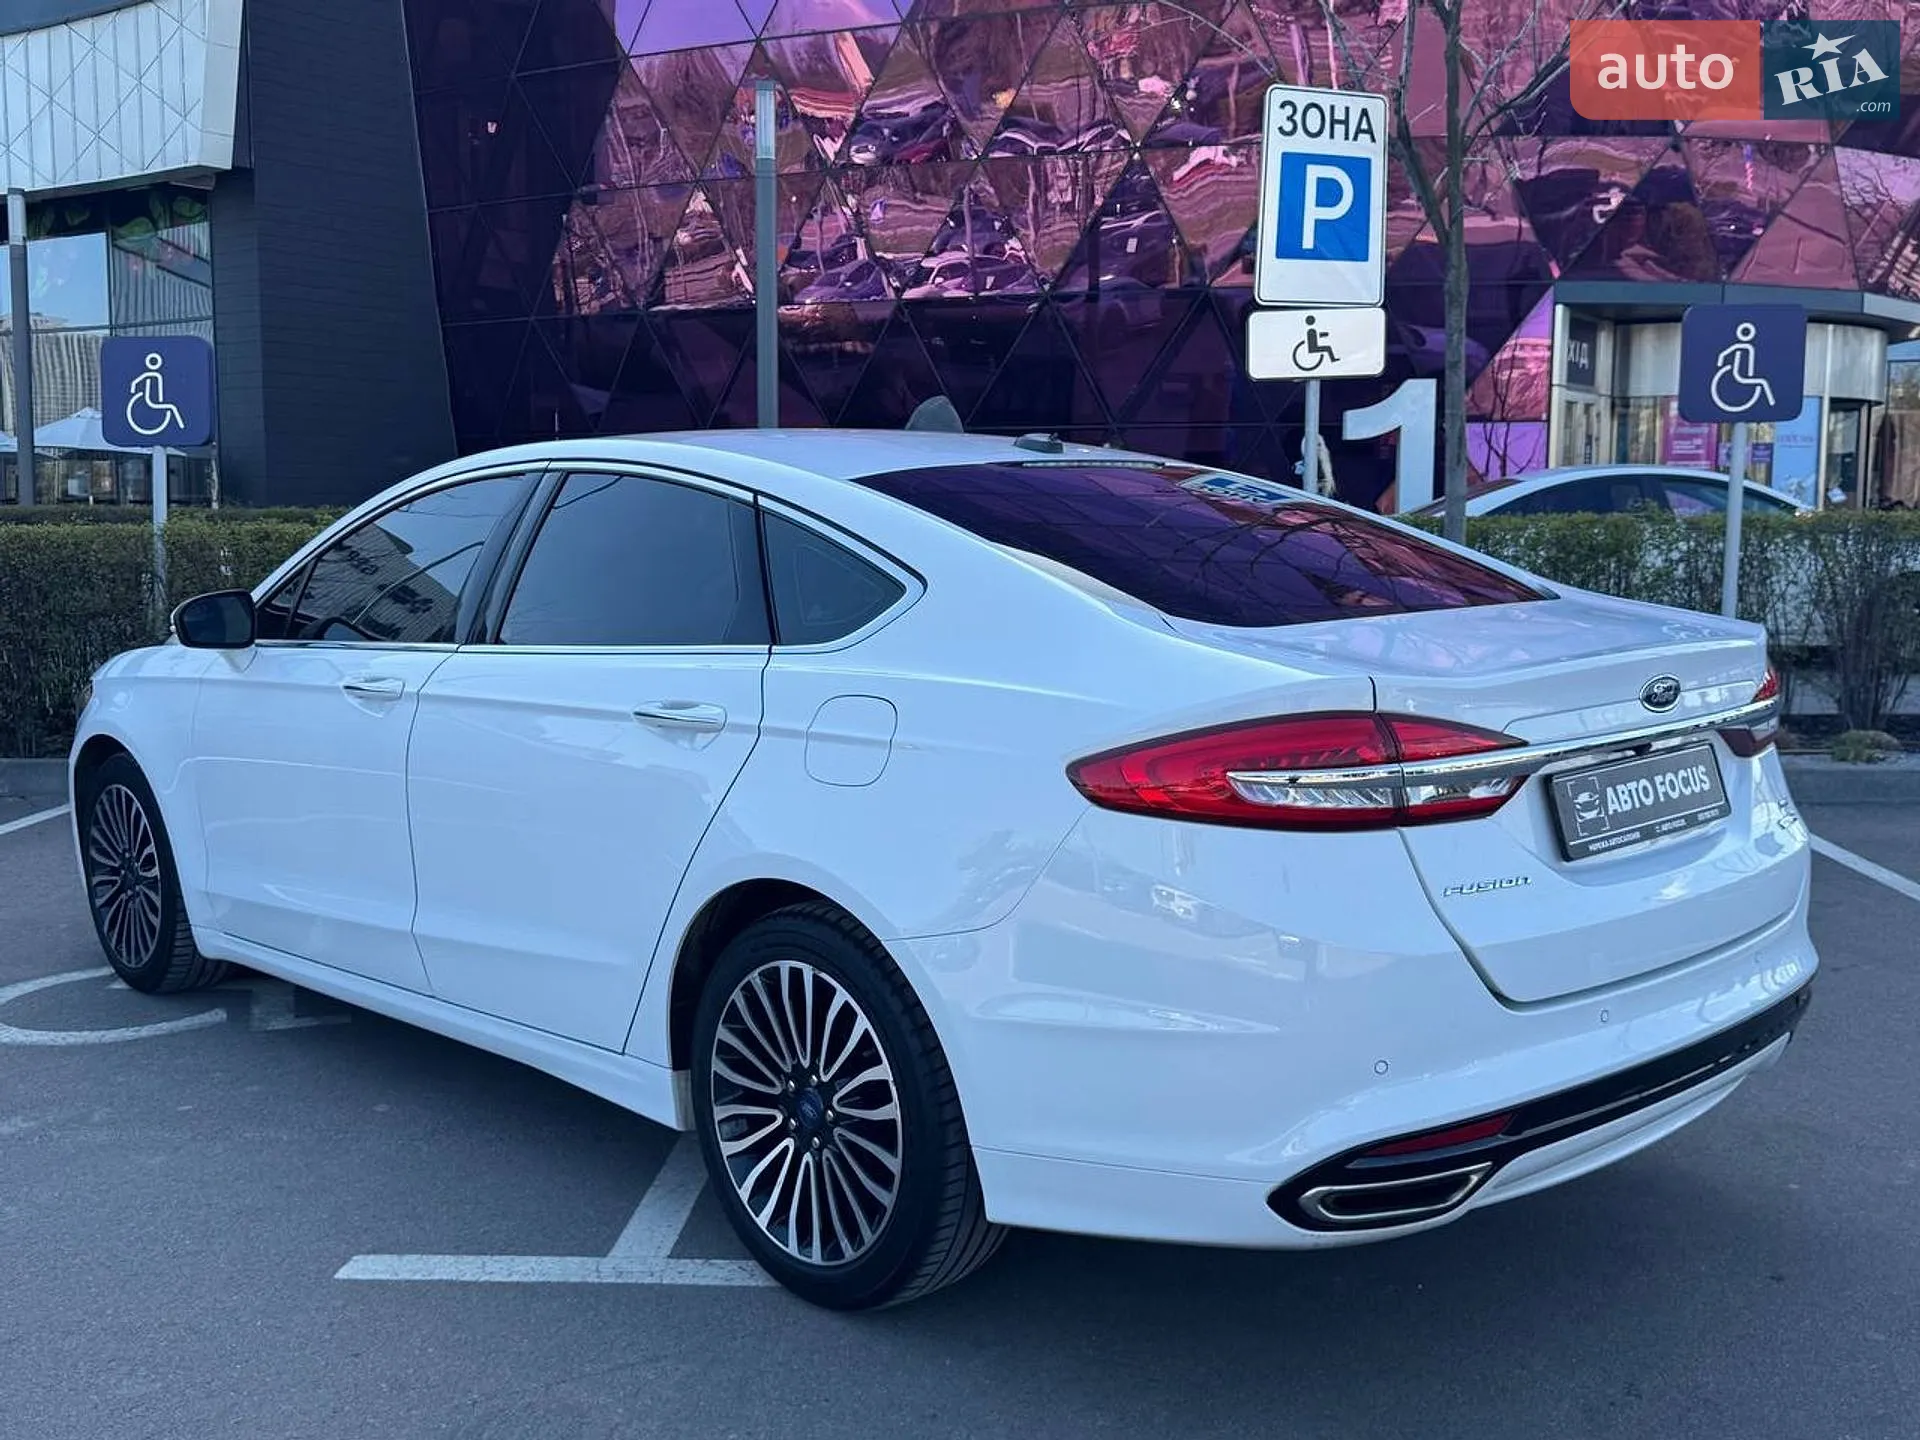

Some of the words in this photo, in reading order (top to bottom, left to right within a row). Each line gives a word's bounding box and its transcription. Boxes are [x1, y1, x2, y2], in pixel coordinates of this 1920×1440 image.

[1277, 100, 1376, 143] ЗОНА
[1302, 163, 1355, 250] P
[1342, 377, 1438, 514] 1
[1654, 765, 1711, 802] FOCUS
